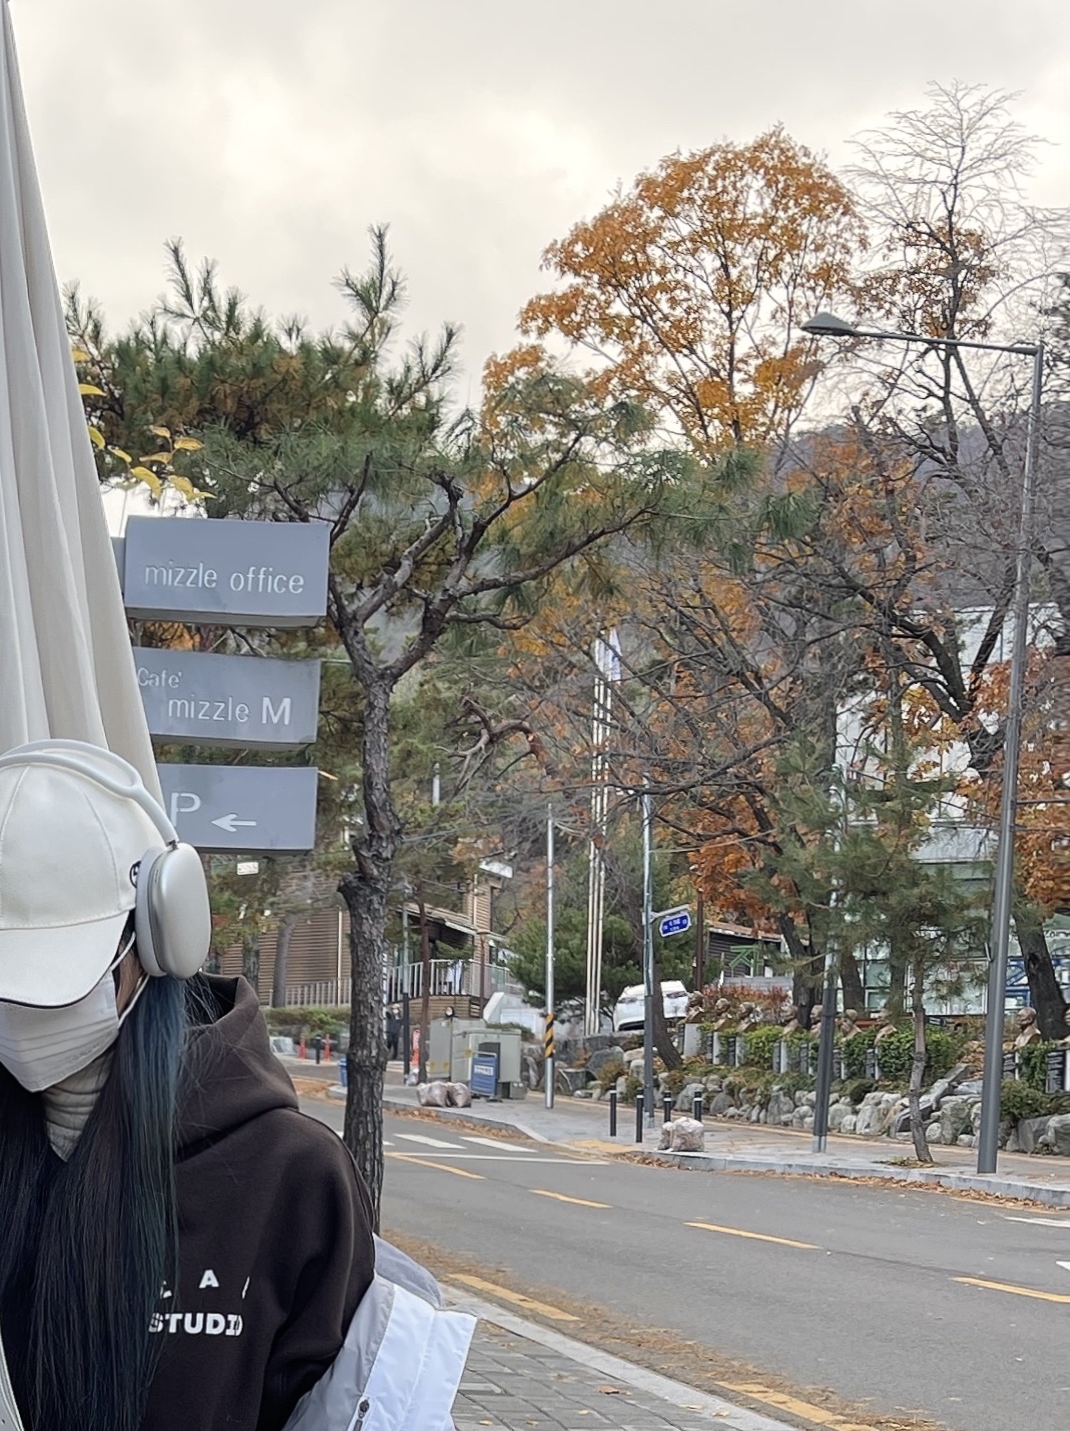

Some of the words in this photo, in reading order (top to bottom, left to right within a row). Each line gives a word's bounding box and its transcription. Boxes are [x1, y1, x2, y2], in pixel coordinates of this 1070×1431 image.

[145, 560, 218, 588] mizzle
[230, 566, 304, 594] office
[168, 693, 250, 723] mizzle
[261, 696, 292, 726] M
[170, 792, 201, 828] P
